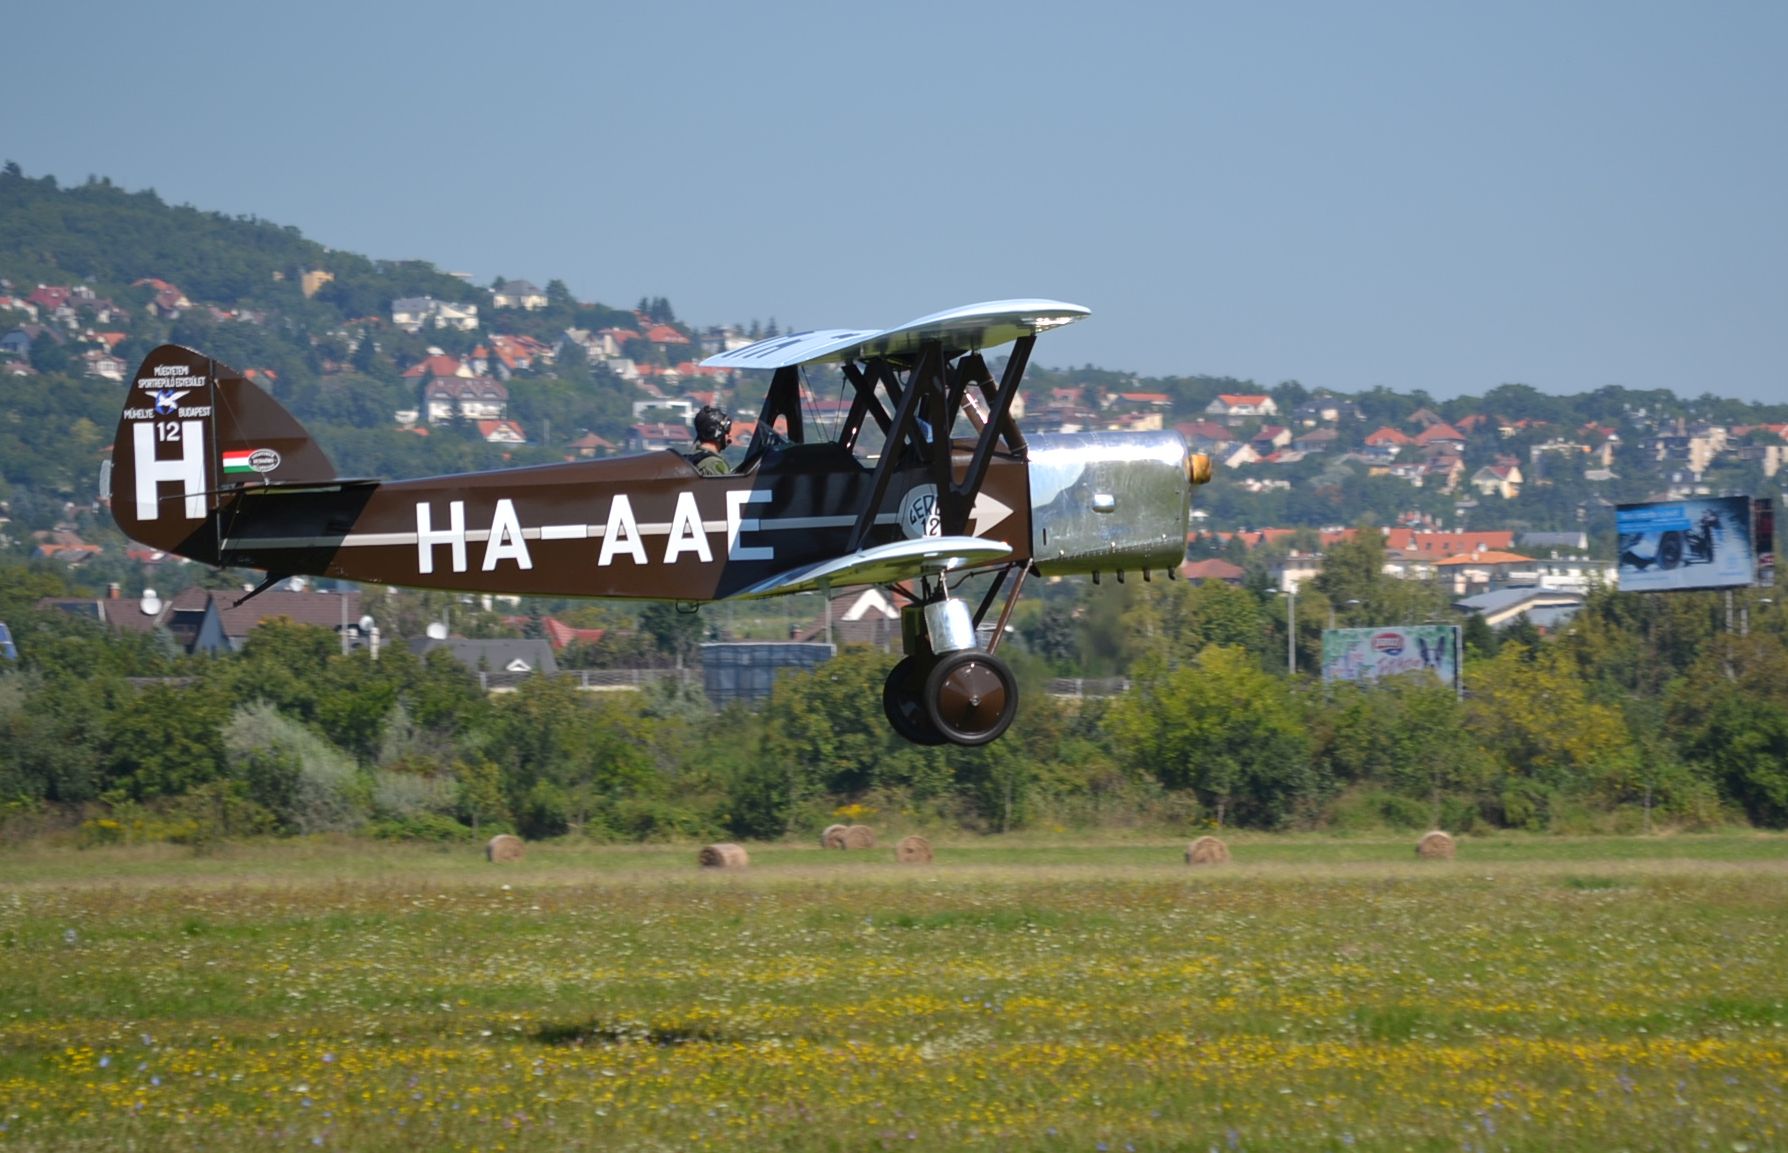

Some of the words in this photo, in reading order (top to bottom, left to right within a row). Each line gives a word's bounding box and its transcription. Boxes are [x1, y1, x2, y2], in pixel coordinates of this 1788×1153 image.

[178, 407, 211, 417] BUDAPEST
[157, 422, 181, 441] 12
[133, 421, 207, 520] H
[921, 518, 940, 536] 12
